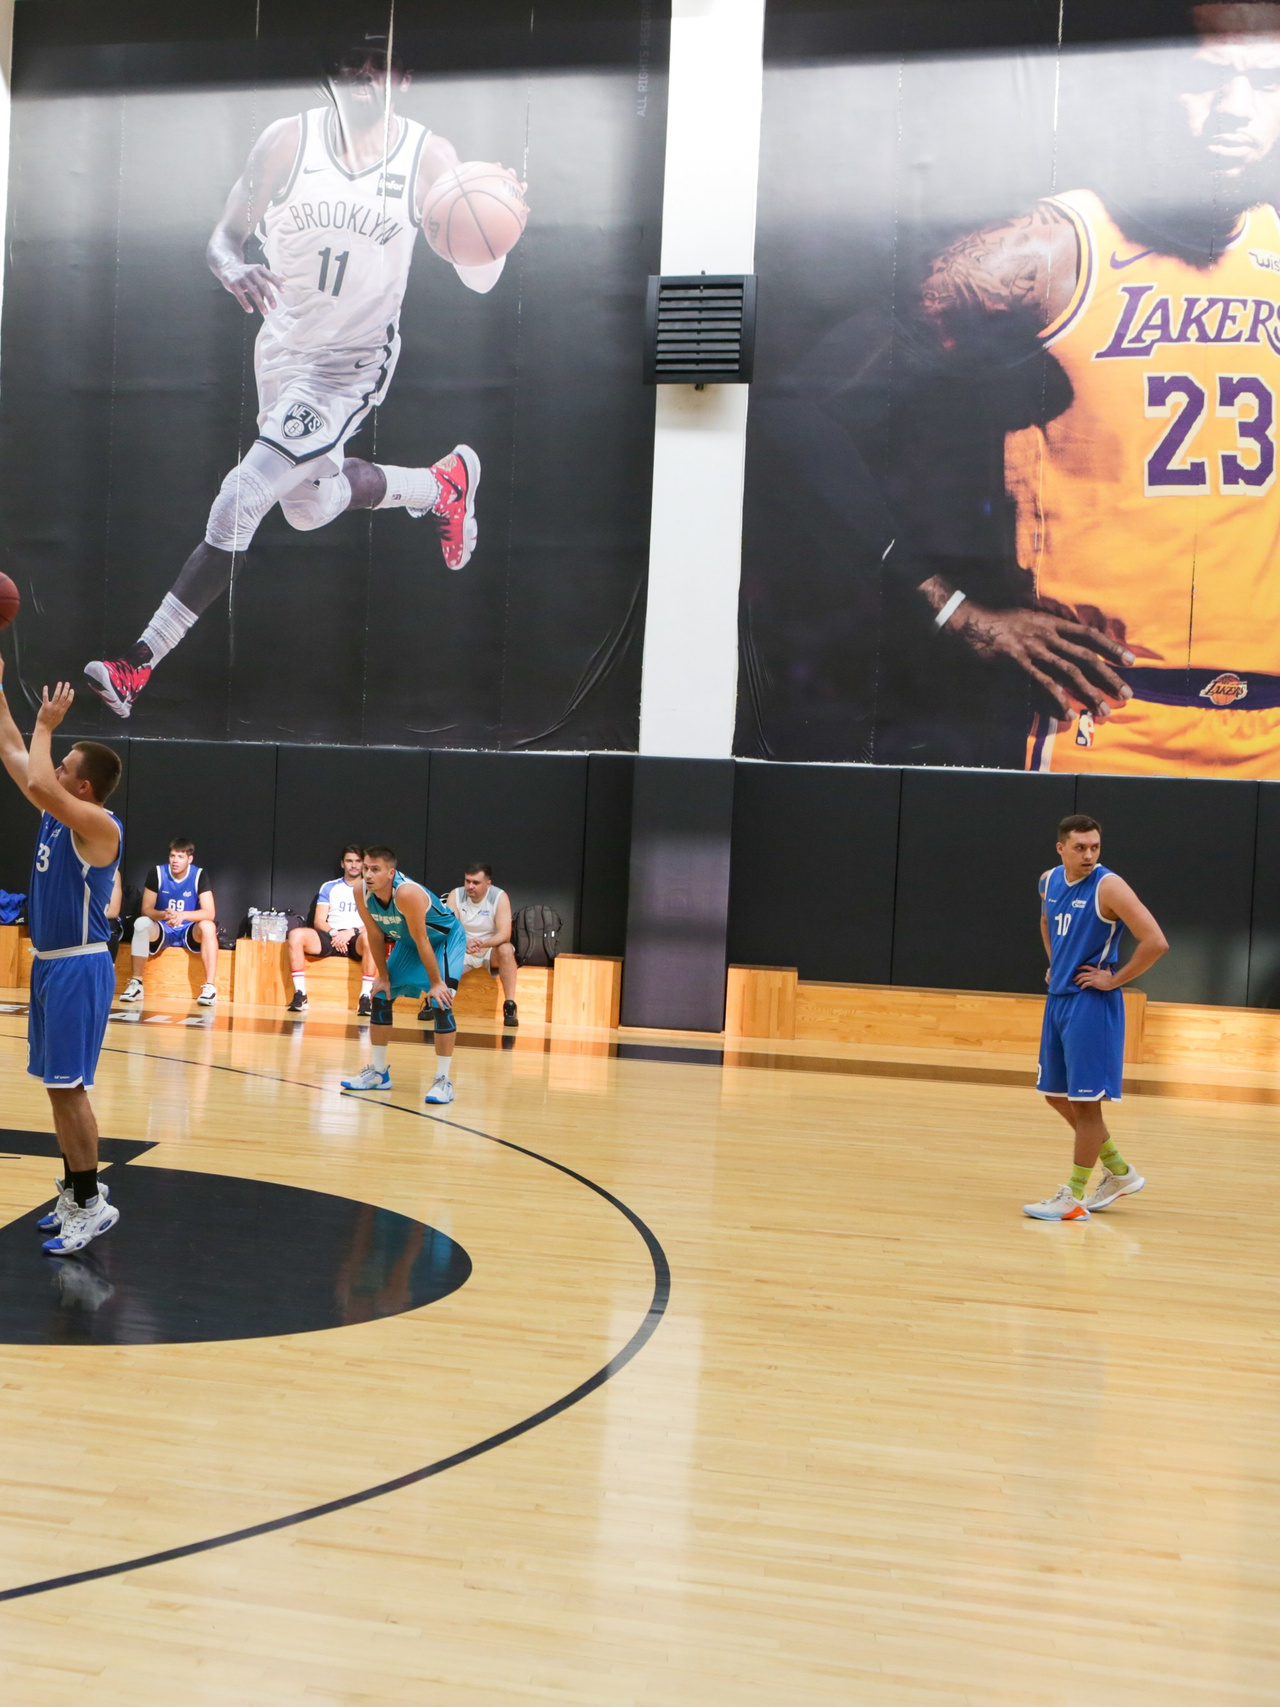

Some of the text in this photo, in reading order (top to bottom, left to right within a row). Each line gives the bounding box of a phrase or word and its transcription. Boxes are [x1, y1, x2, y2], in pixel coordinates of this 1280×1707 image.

[289, 200, 404, 246] BROOKLYN
[317, 246, 350, 297] 11
[287, 403, 322, 433] NETS
[1145, 374, 1275, 494] 23
[1206, 680, 1245, 698] LAKERS
[168, 899, 185, 912] 69
[1054, 912, 1072, 937] 10
